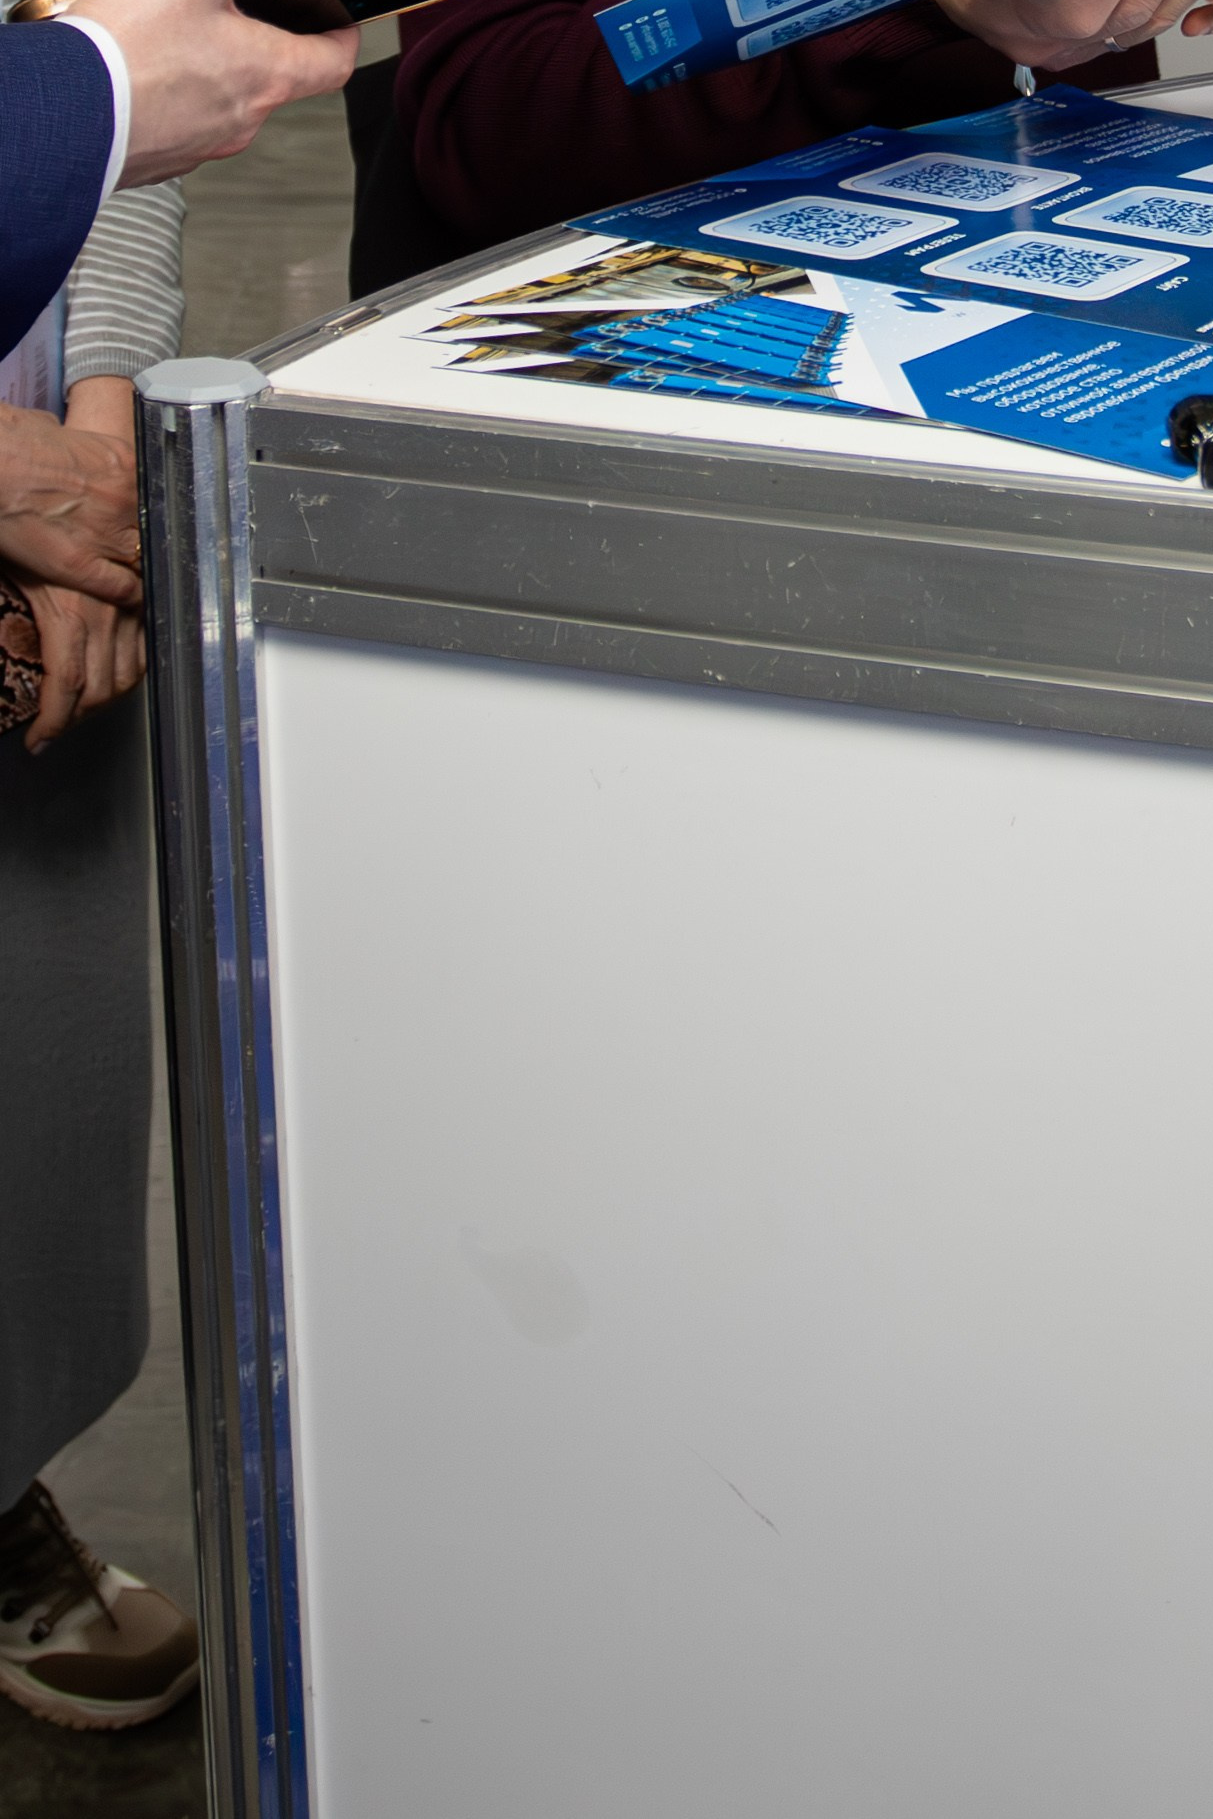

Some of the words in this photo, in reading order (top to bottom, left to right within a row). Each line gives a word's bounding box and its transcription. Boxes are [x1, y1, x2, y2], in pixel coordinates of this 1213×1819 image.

[945, 385, 979, 399] Мы
[976, 351, 1064, 388] предлагаем
[970, 341, 1122, 403] высококачественное
[994, 364, 1107, 409] оборудование,
[1016, 386, 1083, 414] которое
[1078, 368, 1124, 389] стало
[1039, 386, 1113, 418] отличной
[1108, 343, 1213, 390] альтернативой
[1062, 381, 1160, 424] европейским
